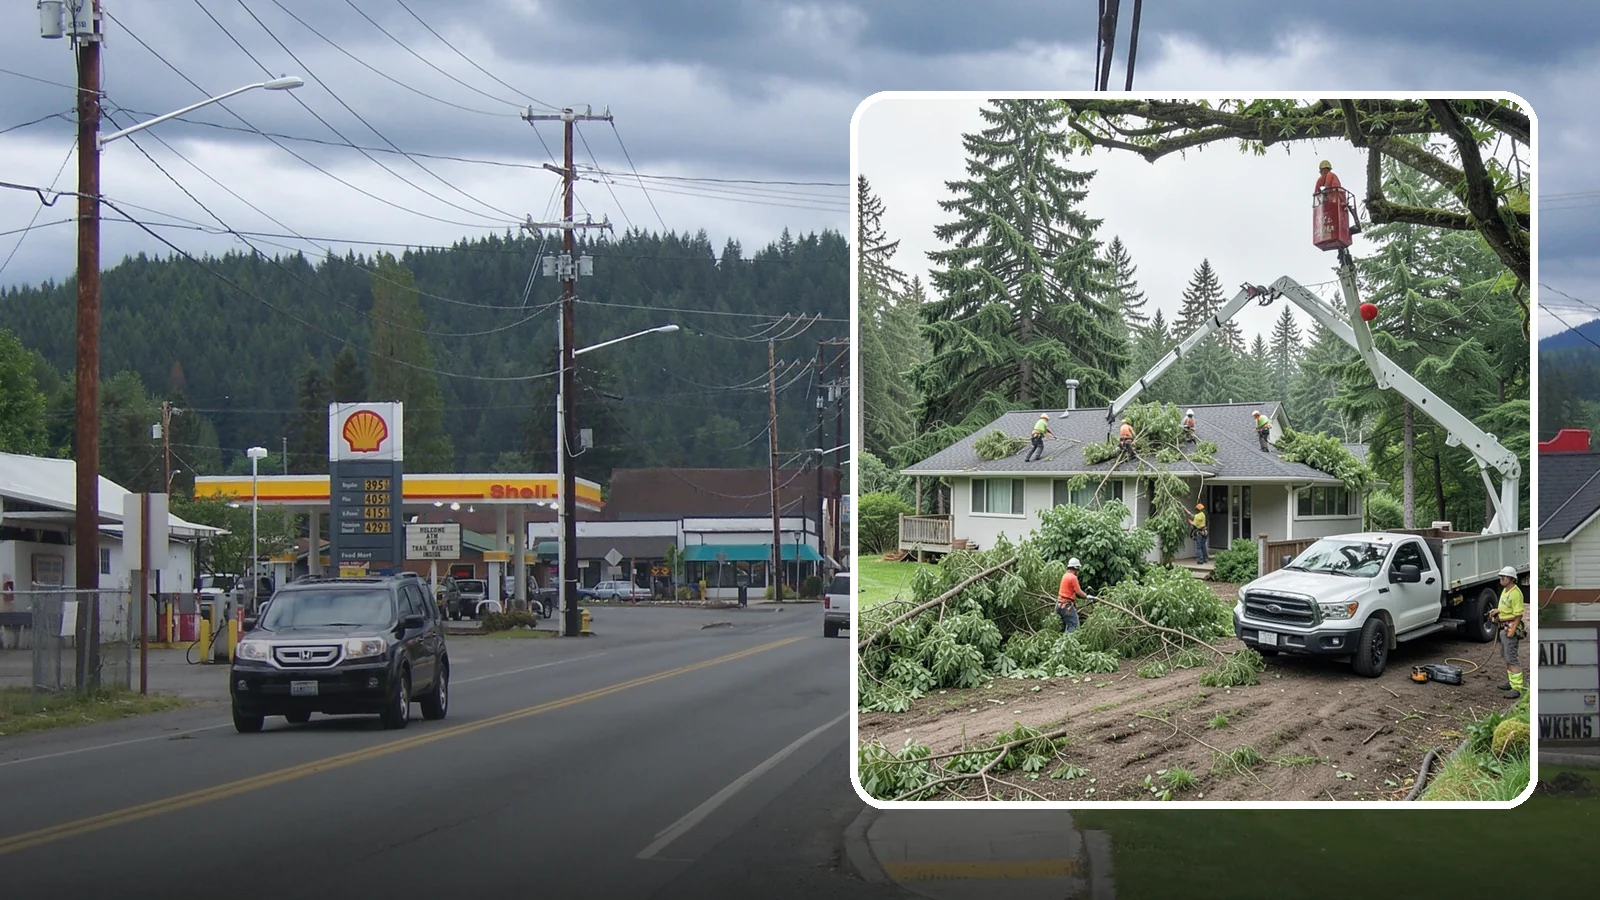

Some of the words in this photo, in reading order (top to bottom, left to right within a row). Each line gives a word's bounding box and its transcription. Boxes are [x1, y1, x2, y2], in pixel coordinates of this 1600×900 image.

[342, 481, 358, 489] Regular
[366, 480, 383, 490] 395
[490, 484, 547, 499] Shell
[366, 494, 383, 504] 405
[366, 508, 383, 518] 415
[366, 522, 383, 533] 429
